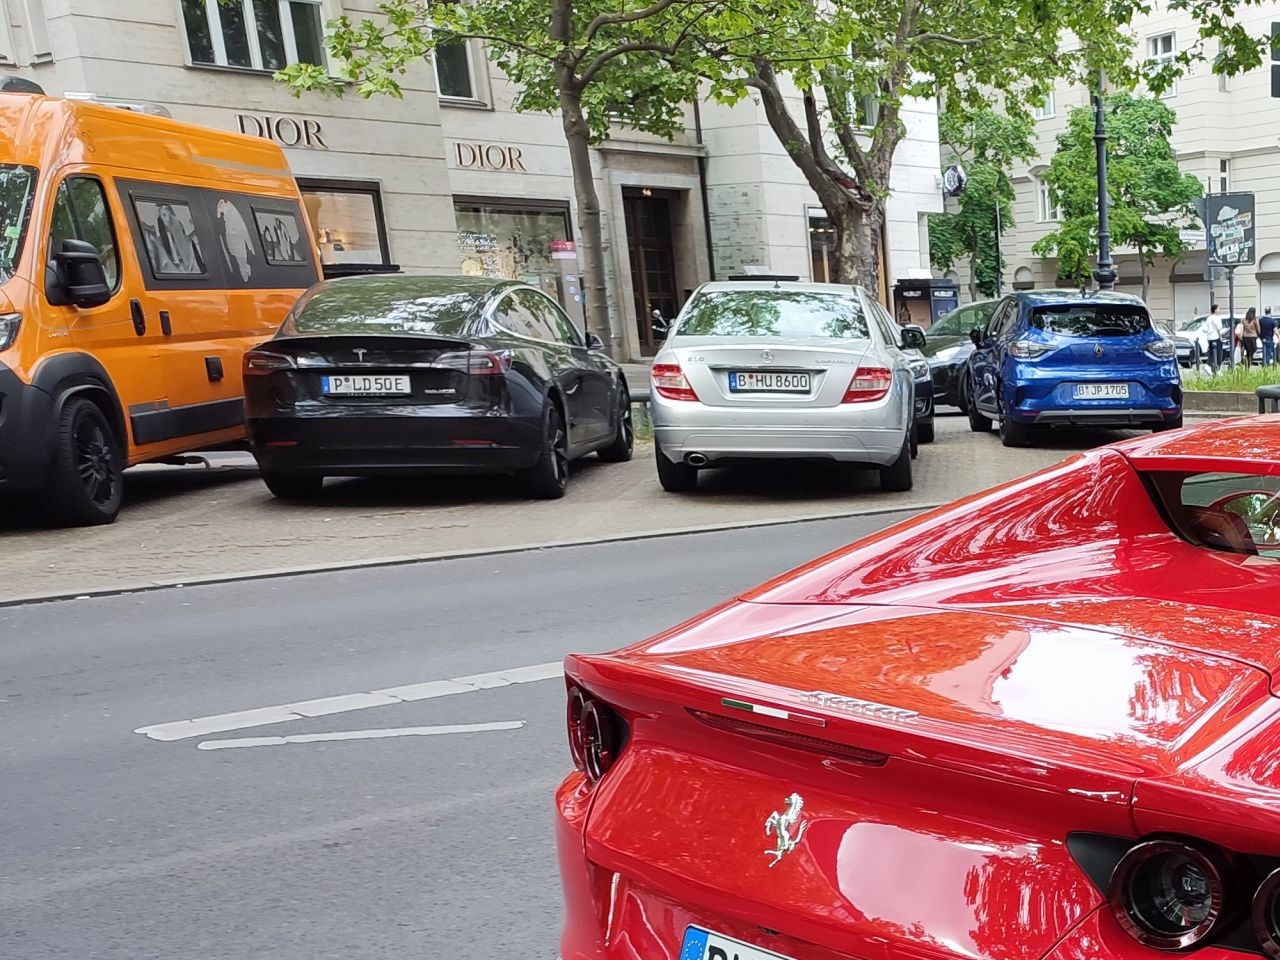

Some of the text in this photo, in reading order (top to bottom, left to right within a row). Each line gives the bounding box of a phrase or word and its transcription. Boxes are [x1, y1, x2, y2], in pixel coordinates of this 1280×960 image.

[235, 113, 328, 149] DIOR
[453, 142, 527, 172] DIOR
[776, 375, 808, 388] 8600
[1104, 385, 1127, 395] 1705
